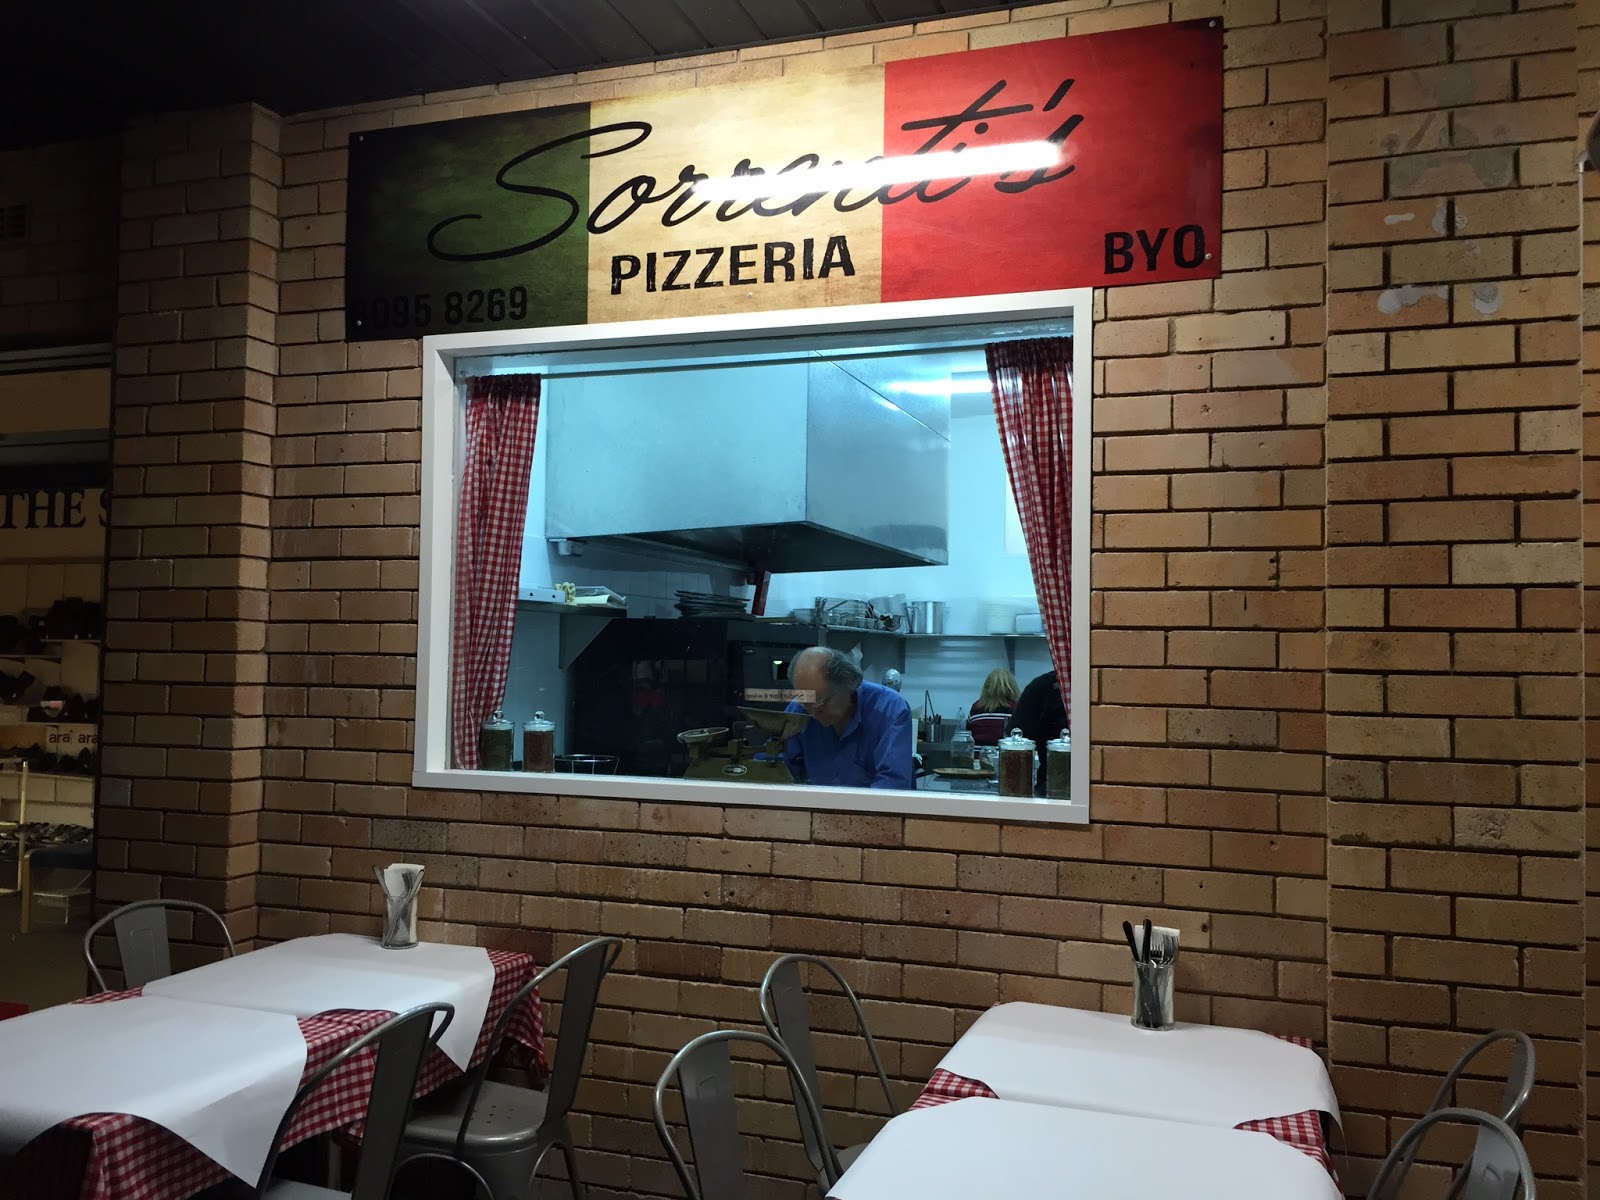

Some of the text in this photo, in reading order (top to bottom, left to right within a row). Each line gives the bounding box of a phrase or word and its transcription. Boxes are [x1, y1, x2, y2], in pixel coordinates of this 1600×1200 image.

[610, 235, 856, 296] PIZZERIA
[1104, 224, 1206, 275] BYO
[445, 286, 528, 325] 8269
[0, 489, 86, 529] THE
[49, 733, 70, 743] ara
